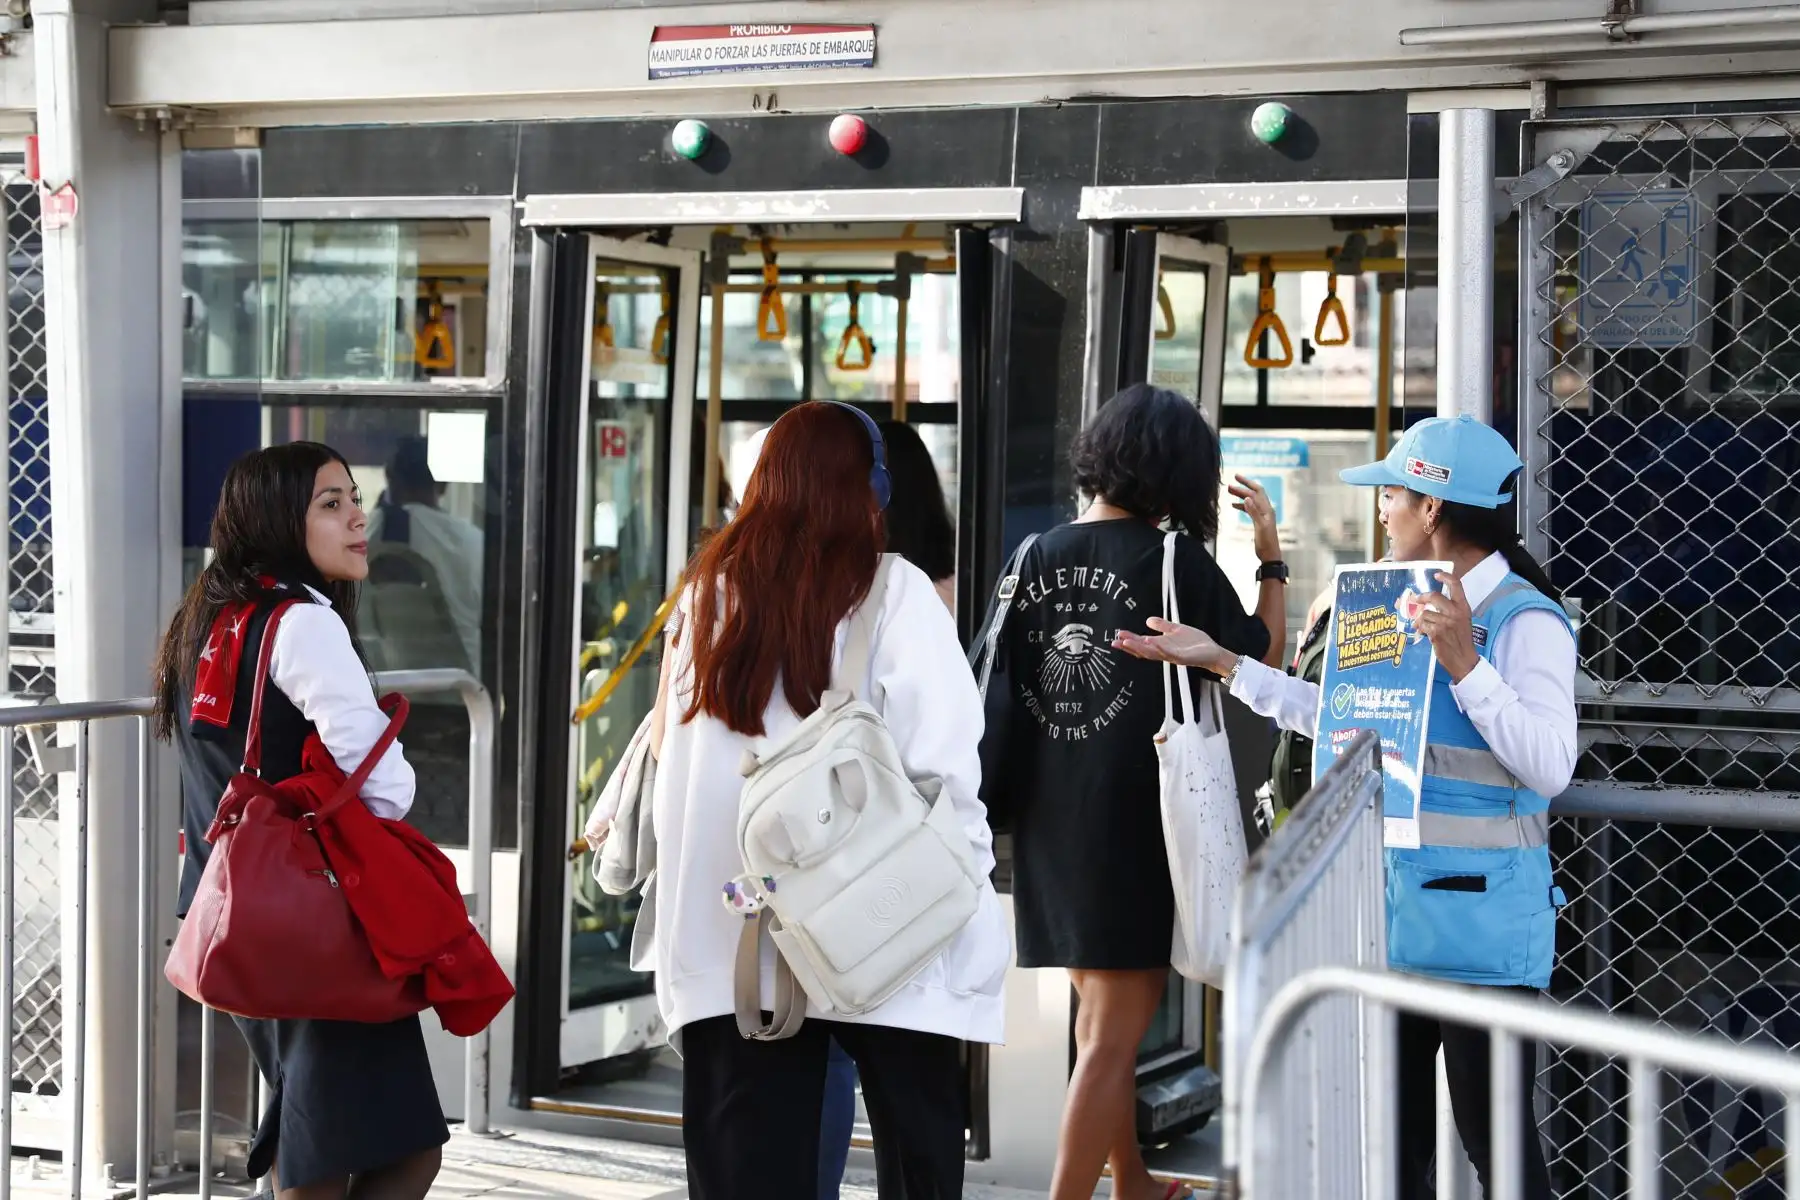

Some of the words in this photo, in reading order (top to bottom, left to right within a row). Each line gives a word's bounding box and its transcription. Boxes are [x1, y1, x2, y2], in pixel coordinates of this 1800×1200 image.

[730, 25, 792, 36] PROHIBIDO
[651, 46, 702, 63] MANIPULAR
[704, 46, 713, 59] O
[715, 45, 749, 60] FORZAR
[752, 43, 768, 58] LAS
[770, 41, 807, 57] PUERTAS
[809, 41, 821, 55] DE
[823, 39, 874, 55] EMBARQUE
[1026, 566, 1128, 604] ELEMENT
[1354, 709, 1373, 720] deben
[1048, 723, 1060, 739] TO
[1066, 724, 1089, 740] THE
